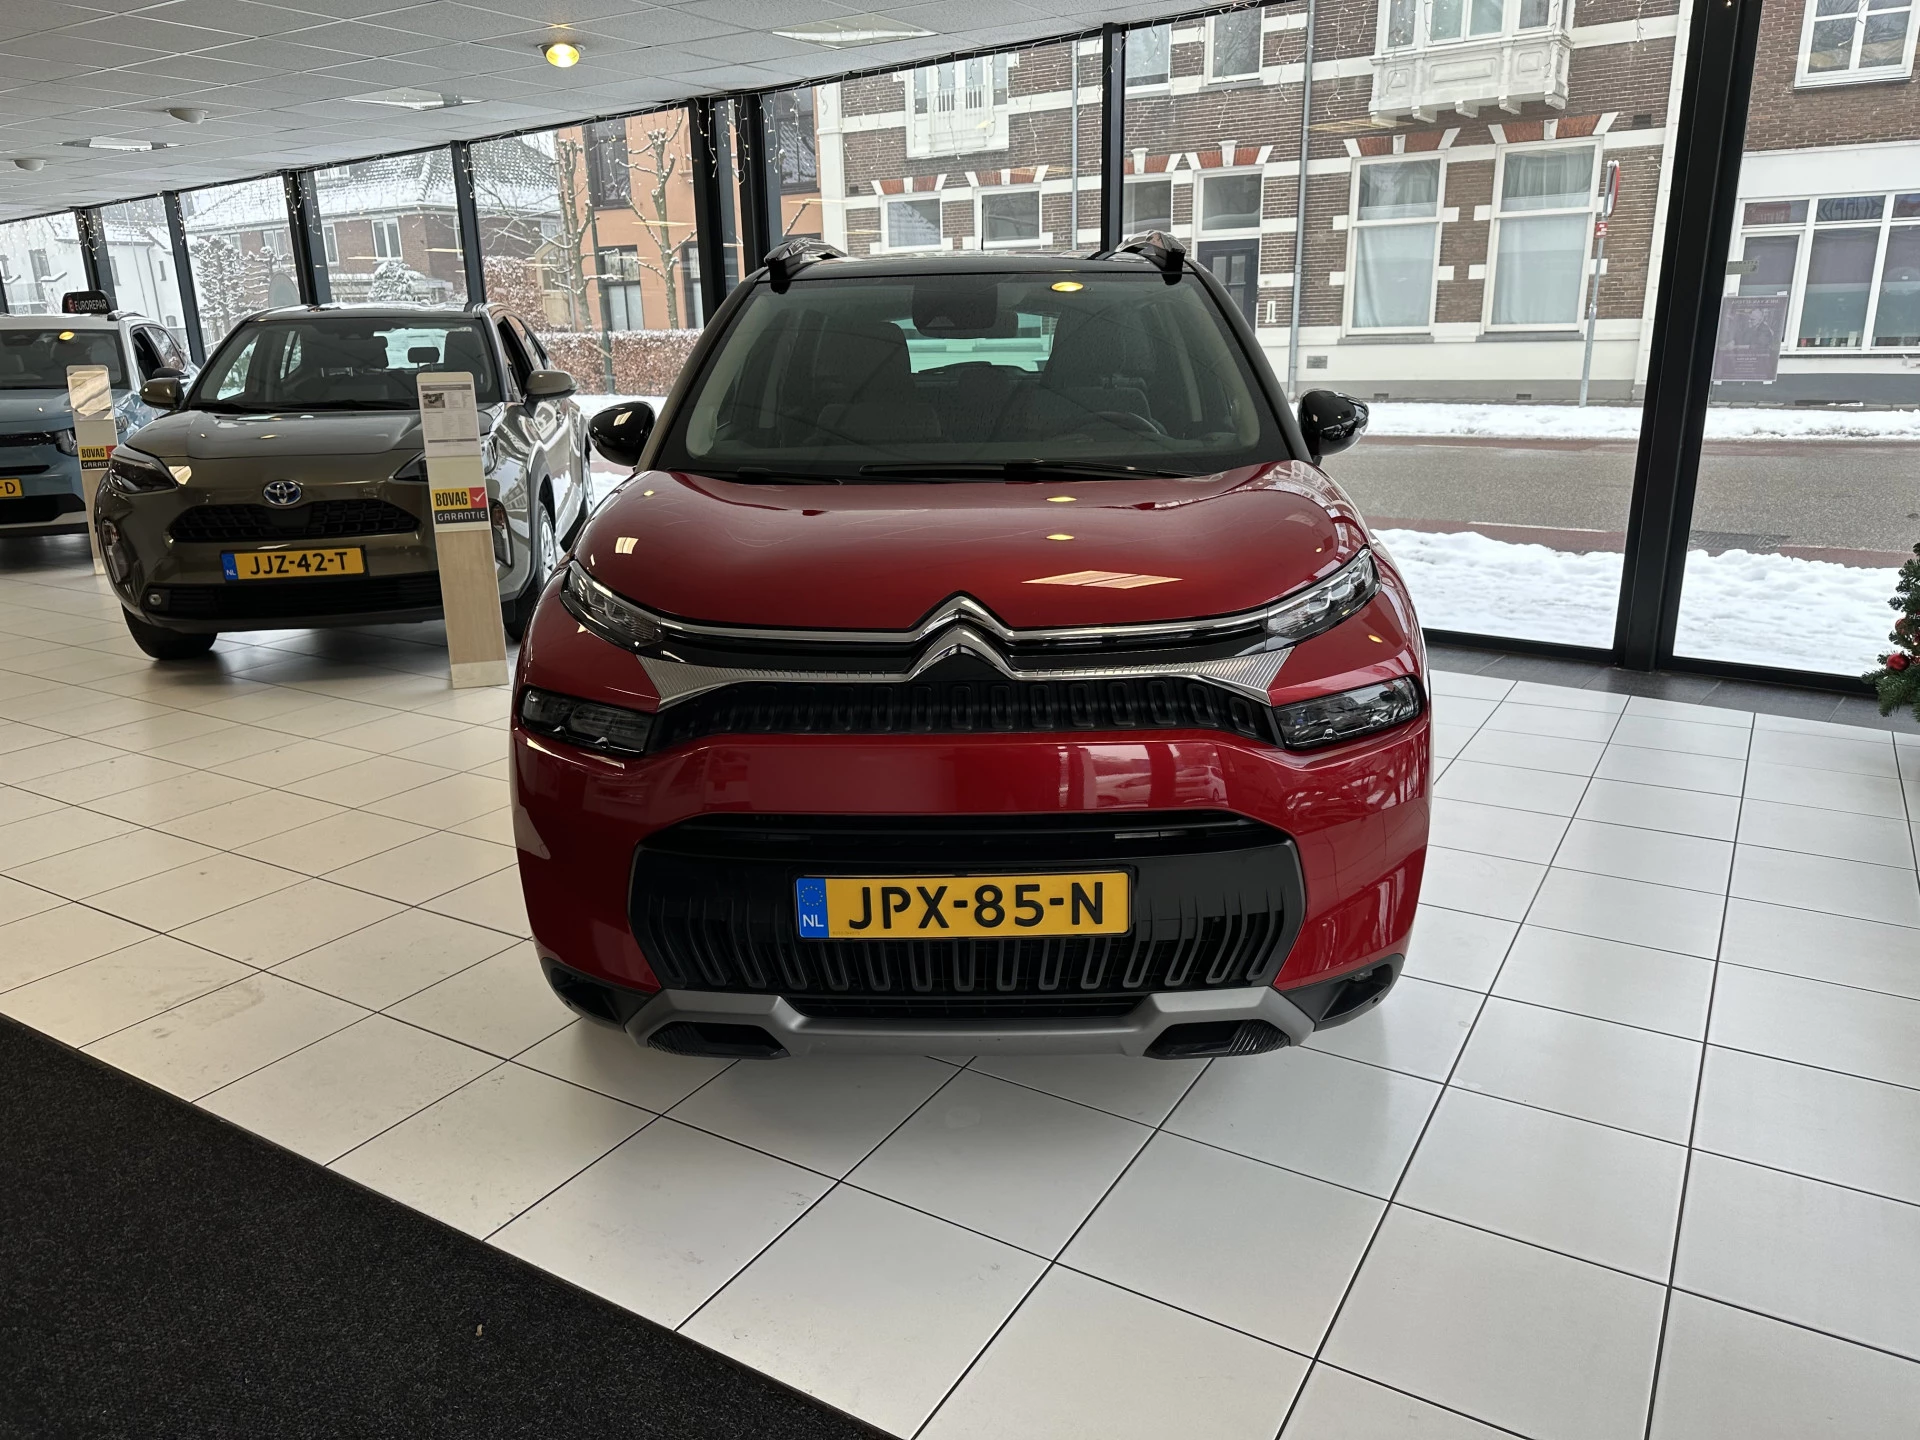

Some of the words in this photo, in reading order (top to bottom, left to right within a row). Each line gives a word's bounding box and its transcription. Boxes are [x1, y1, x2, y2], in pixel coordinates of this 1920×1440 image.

[74, 299, 108, 311] EUROREPAR
[81, 447, 105, 459] BOVAG
[435, 491, 468, 507] BOVAG
[437, 510, 486, 522] GARANTIE
[250, 551, 348, 575] JJZ-42-T
[802, 914, 825, 928] NL
[848, 881, 1104, 930] JPX-85-N
